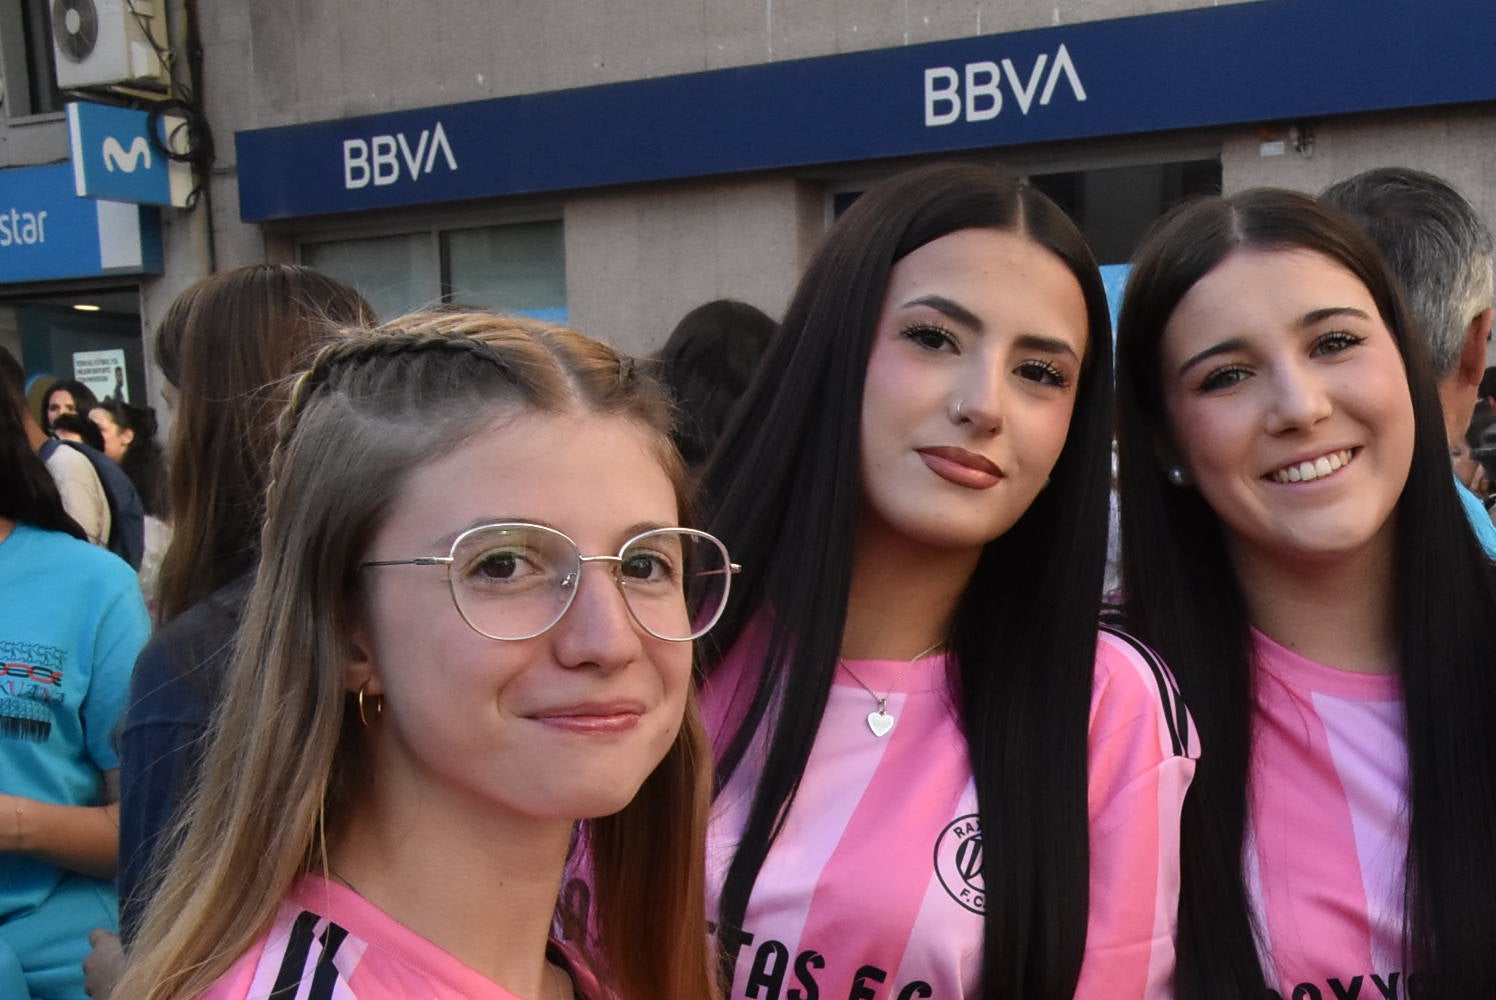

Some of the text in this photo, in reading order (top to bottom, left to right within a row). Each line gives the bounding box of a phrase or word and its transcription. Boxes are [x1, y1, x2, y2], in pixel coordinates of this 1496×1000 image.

[923, 44, 1086, 127] BBVA
[342, 121, 457, 190] BBVA
[0, 208, 48, 247] star
